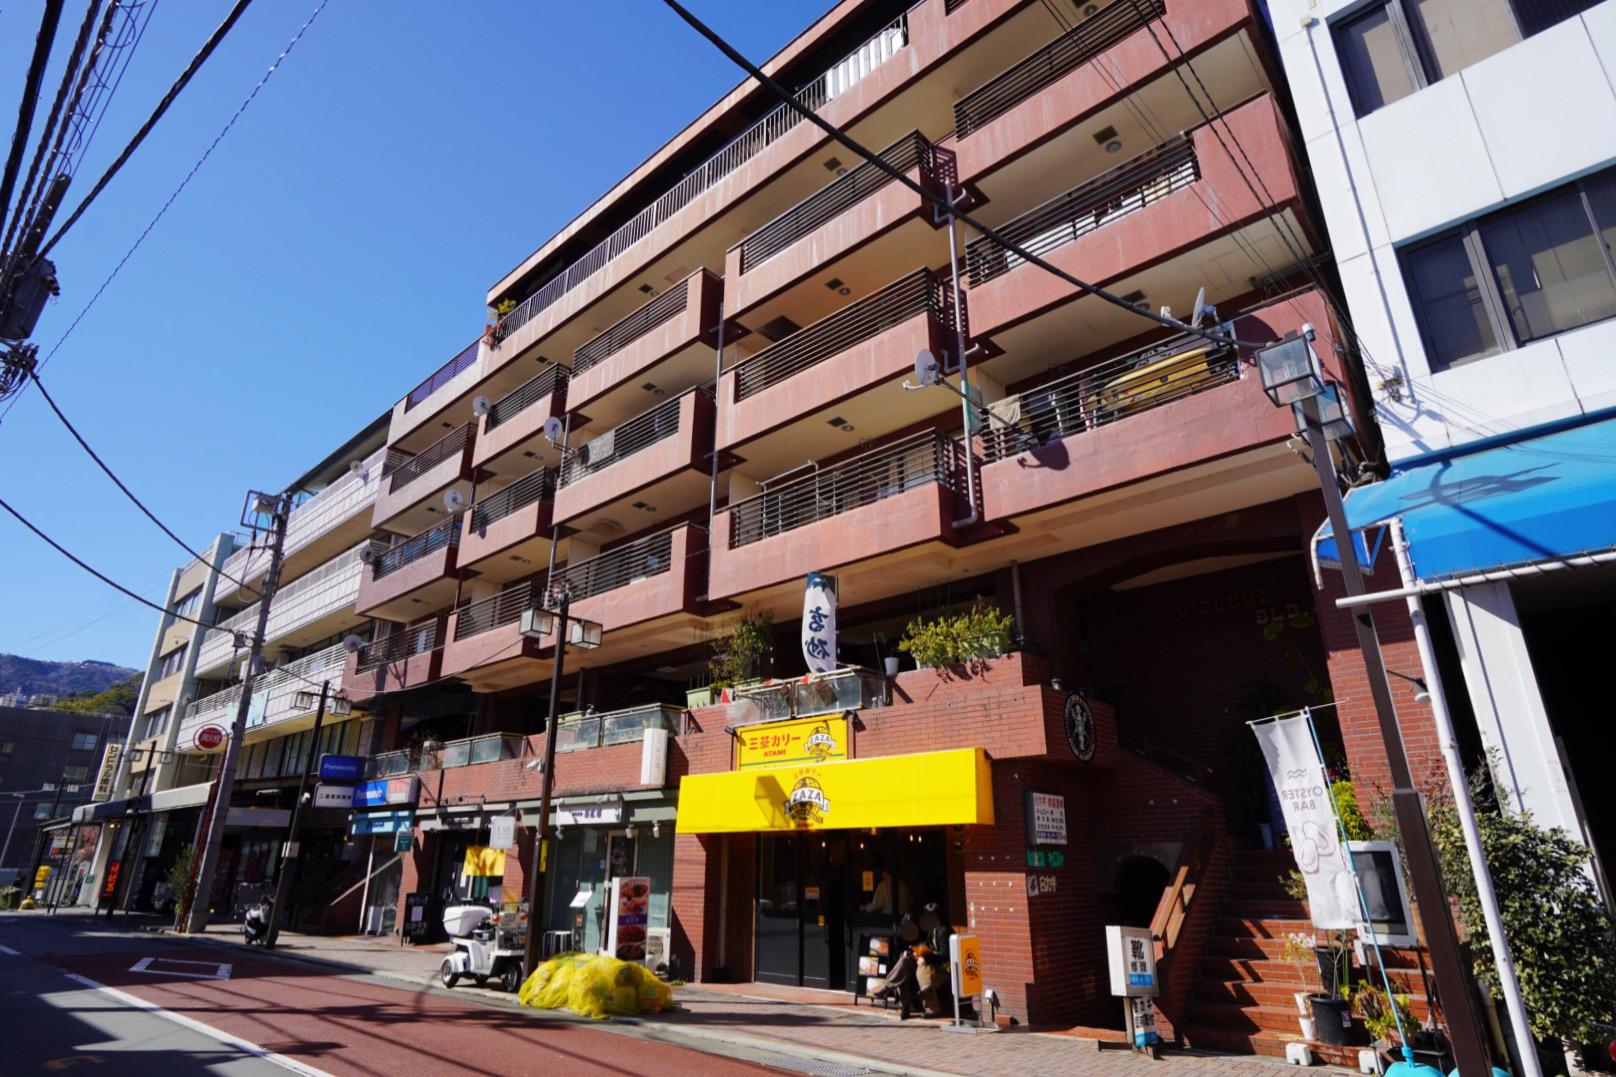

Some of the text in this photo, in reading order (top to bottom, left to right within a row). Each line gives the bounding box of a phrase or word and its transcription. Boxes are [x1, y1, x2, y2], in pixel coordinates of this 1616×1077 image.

[749, 733, 801, 751] 三茶カリー
[809, 734, 831, 744] ZAZA
[763, 749, 786, 757] ATAMI
[793, 789, 822, 802] ZAZA
